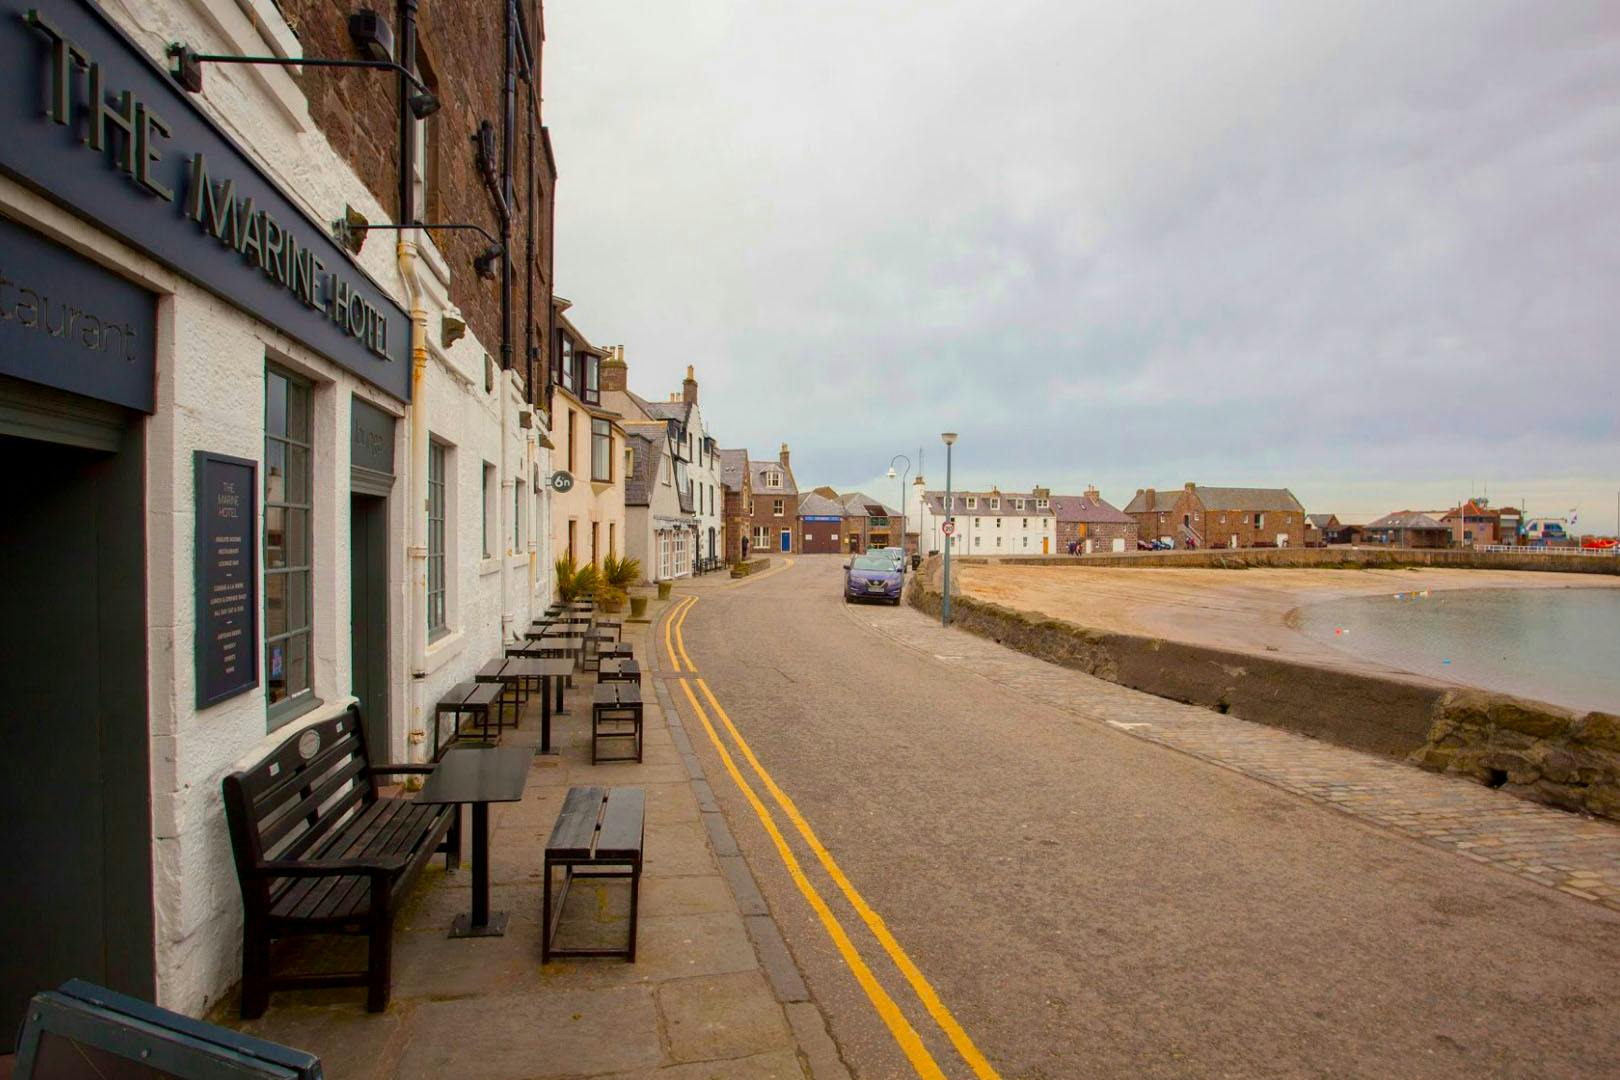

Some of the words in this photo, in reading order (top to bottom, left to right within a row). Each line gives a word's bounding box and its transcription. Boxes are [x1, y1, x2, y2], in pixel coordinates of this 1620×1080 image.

[28, 9, 174, 201] THE
[190, 153, 326, 312] MARINE
[332, 274, 393, 362] HOTEL
